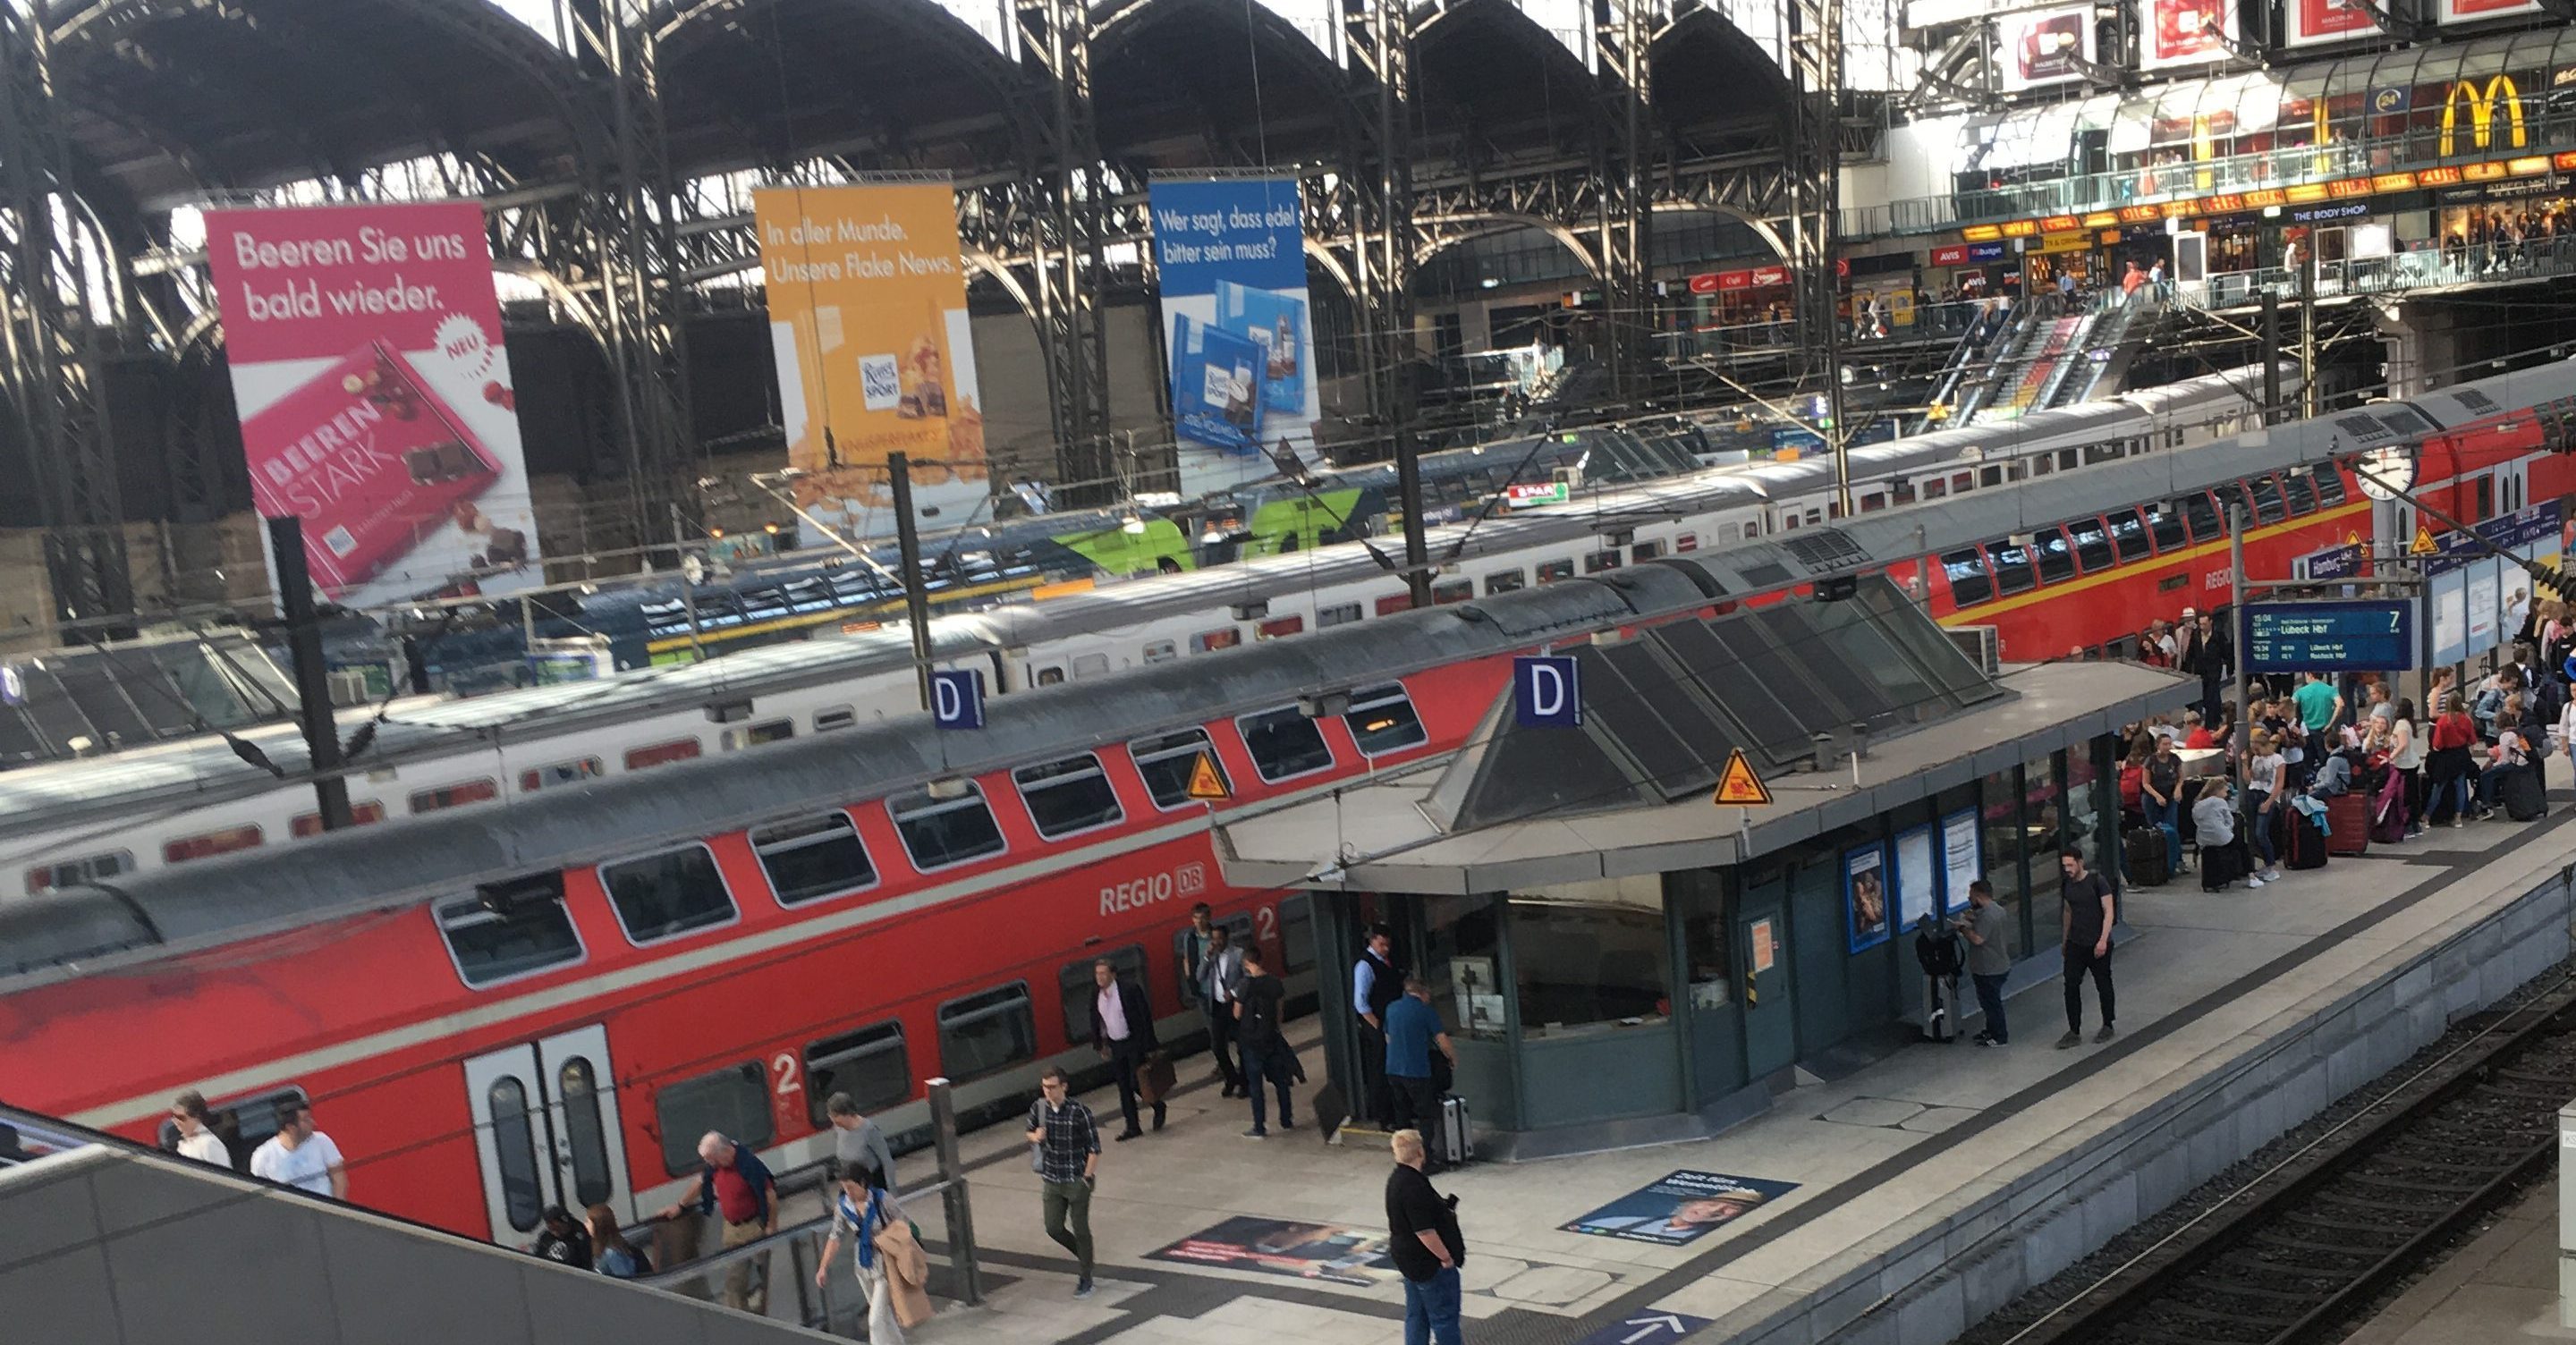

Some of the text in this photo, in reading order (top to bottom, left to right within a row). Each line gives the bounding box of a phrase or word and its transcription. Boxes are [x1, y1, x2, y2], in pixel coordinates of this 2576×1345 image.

[766, 213, 909, 247] In aller Munde.
[1157, 202, 1296, 237] Wer sagt, dass edel
[2294, 205, 2368, 223] THE BODY SHOP
[233, 225, 467, 270] Beeren Sie uns
[1161, 236, 1277, 266] bitter sein muss?
[1940, 251, 1961, 261] AVIS
[770, 250, 957, 284] Unsere Flake News.
[1968, 276, 1987, 286] AVIS
[242, 273, 445, 322] bald wieder.
[445, 332, 481, 360] NEU
[262, 398, 384, 486] BEEREN
[286, 427, 395, 520] STARK
[1516, 485, 1555, 497] SPAR
[2205, 566, 2233, 590] REGIO
[2281, 625, 2309, 635] Lübeck
[2312, 624, 2327, 634] Hbf
[2389, 611, 2401, 628] 7
[935, 677, 962, 722] D
[1531, 664, 1563, 715] D
[1099, 865, 1203, 917] REGIO DB
[1257, 905, 1277, 941] 2
[772, 1053, 801, 1095] 2
